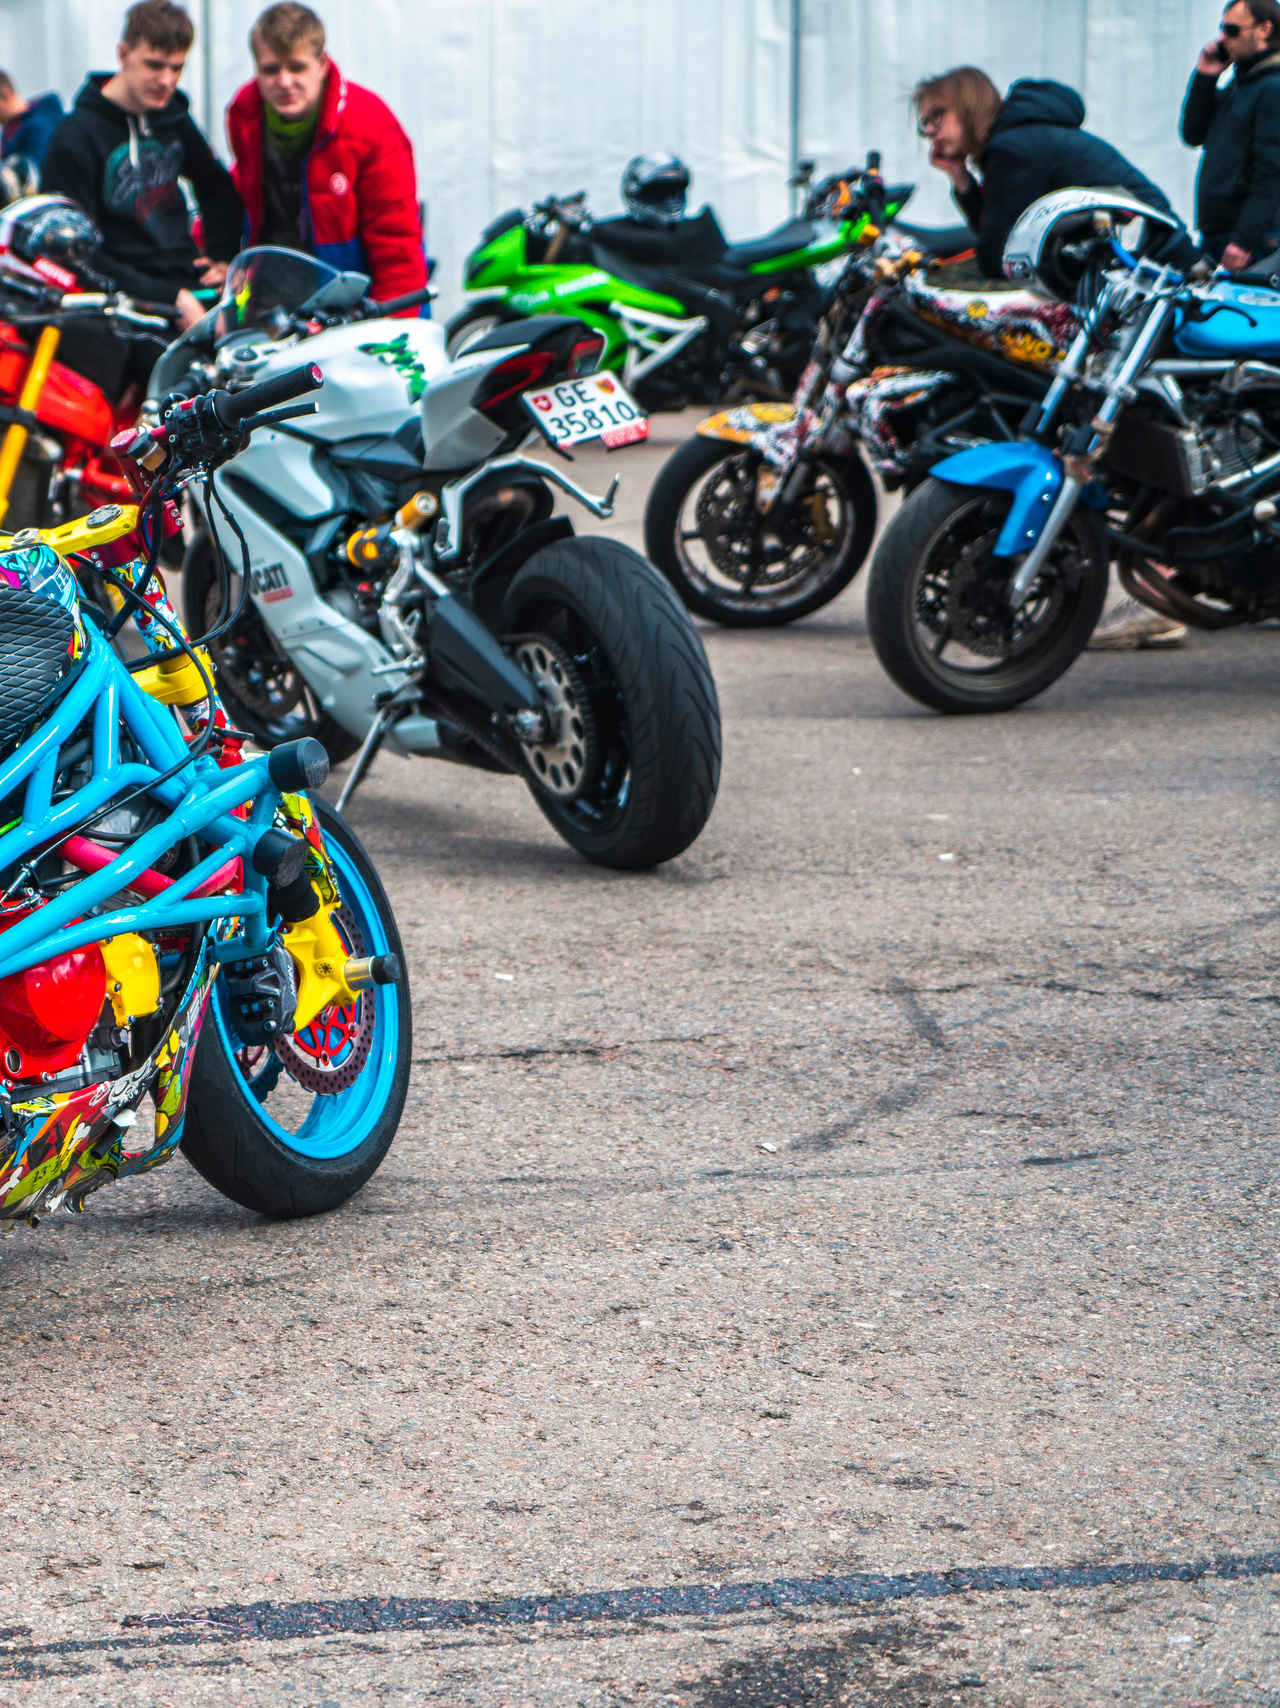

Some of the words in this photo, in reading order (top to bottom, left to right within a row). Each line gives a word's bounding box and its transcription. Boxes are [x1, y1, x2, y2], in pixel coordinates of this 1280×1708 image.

[554, 381, 596, 408] GE
[549, 401, 636, 439] 35810
[249, 562, 289, 596] UCATI
